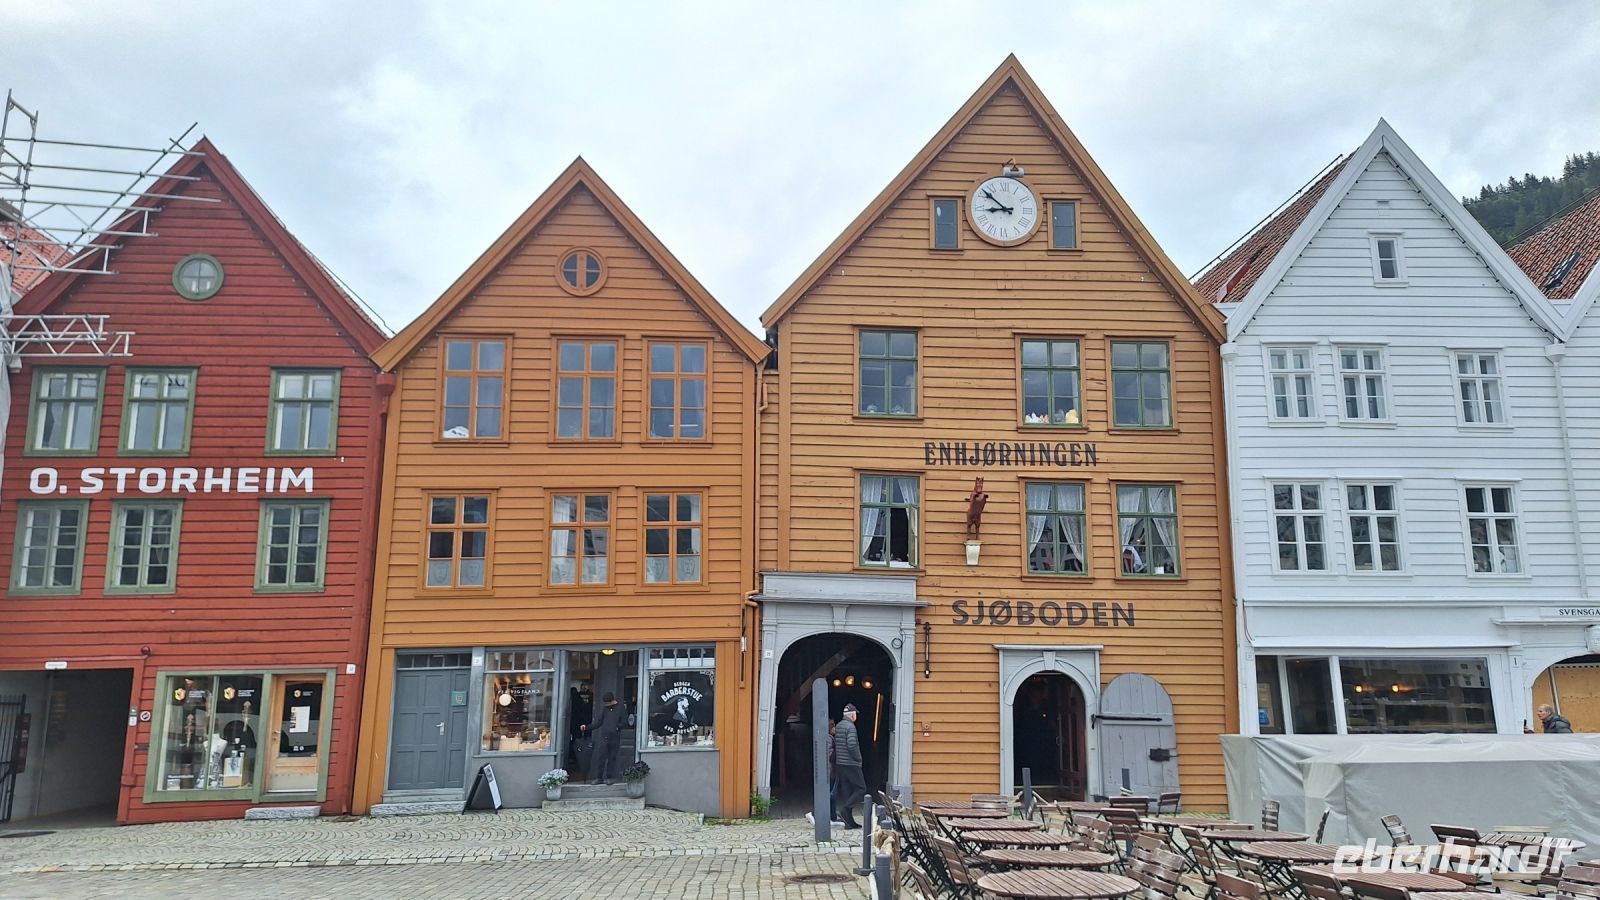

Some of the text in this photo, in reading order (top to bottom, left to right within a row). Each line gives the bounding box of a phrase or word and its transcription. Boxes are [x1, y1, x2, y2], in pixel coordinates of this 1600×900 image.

[924, 441, 1098, 467] ENHJØRNINGEN
[30, 466, 313, 494] O. STORHEIM
[952, 599, 1135, 627] SJØBODEN
[661, 686, 703, 702] BARBERSTUE
